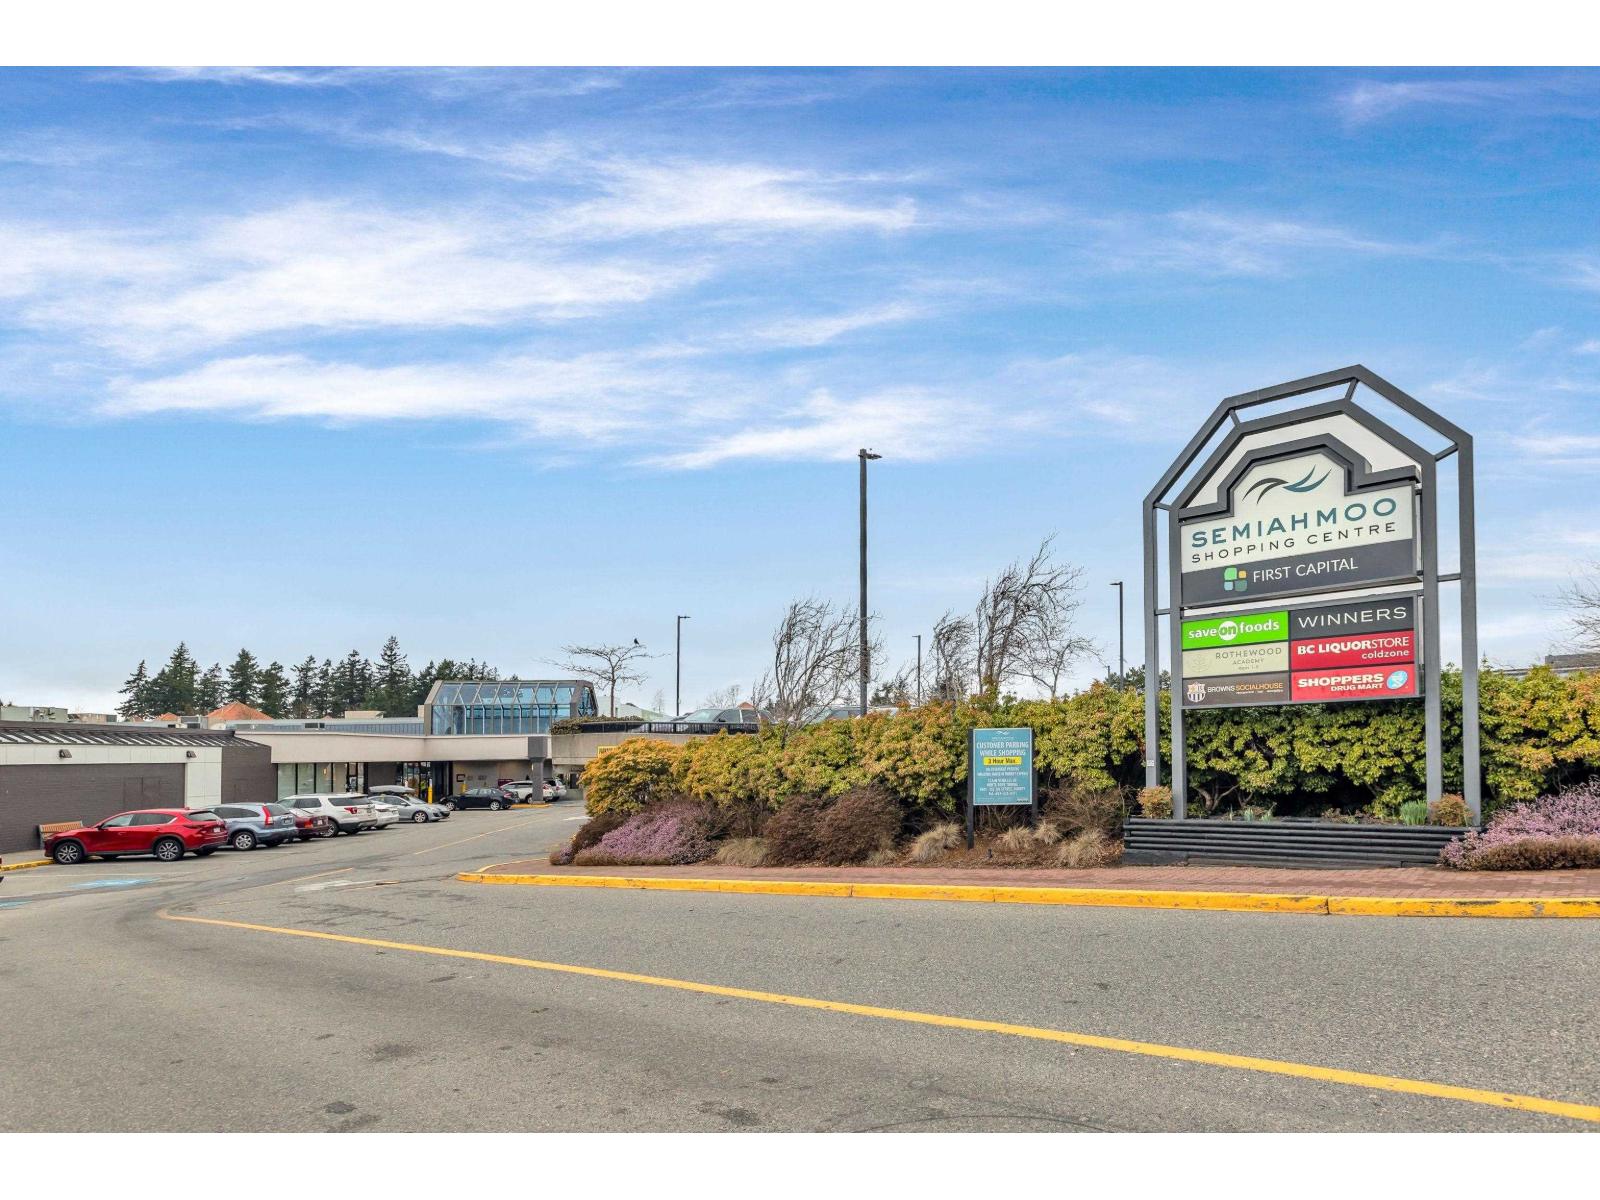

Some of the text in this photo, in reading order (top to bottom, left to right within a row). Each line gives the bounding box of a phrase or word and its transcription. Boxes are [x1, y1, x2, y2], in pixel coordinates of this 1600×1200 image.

[1191, 497, 1397, 548] SEMIAHMOO
[1191, 522, 1396, 563] SHOPPING CENTRE
[1253, 557, 1358, 583] FIRST CAPITAL
[1298, 606, 1407, 629] WINNERS
[1215, 647, 1282, 660] ROTHEWOOD
[1297, 645, 1315, 655] BC
[1361, 649, 1410, 660] coldzone
[1298, 674, 1384, 688] SHOPPERS
[1207, 685, 1235, 693] BROWNS
[1330, 684, 1356, 692] DRUG
[1005, 741, 1029, 749] PARKING
